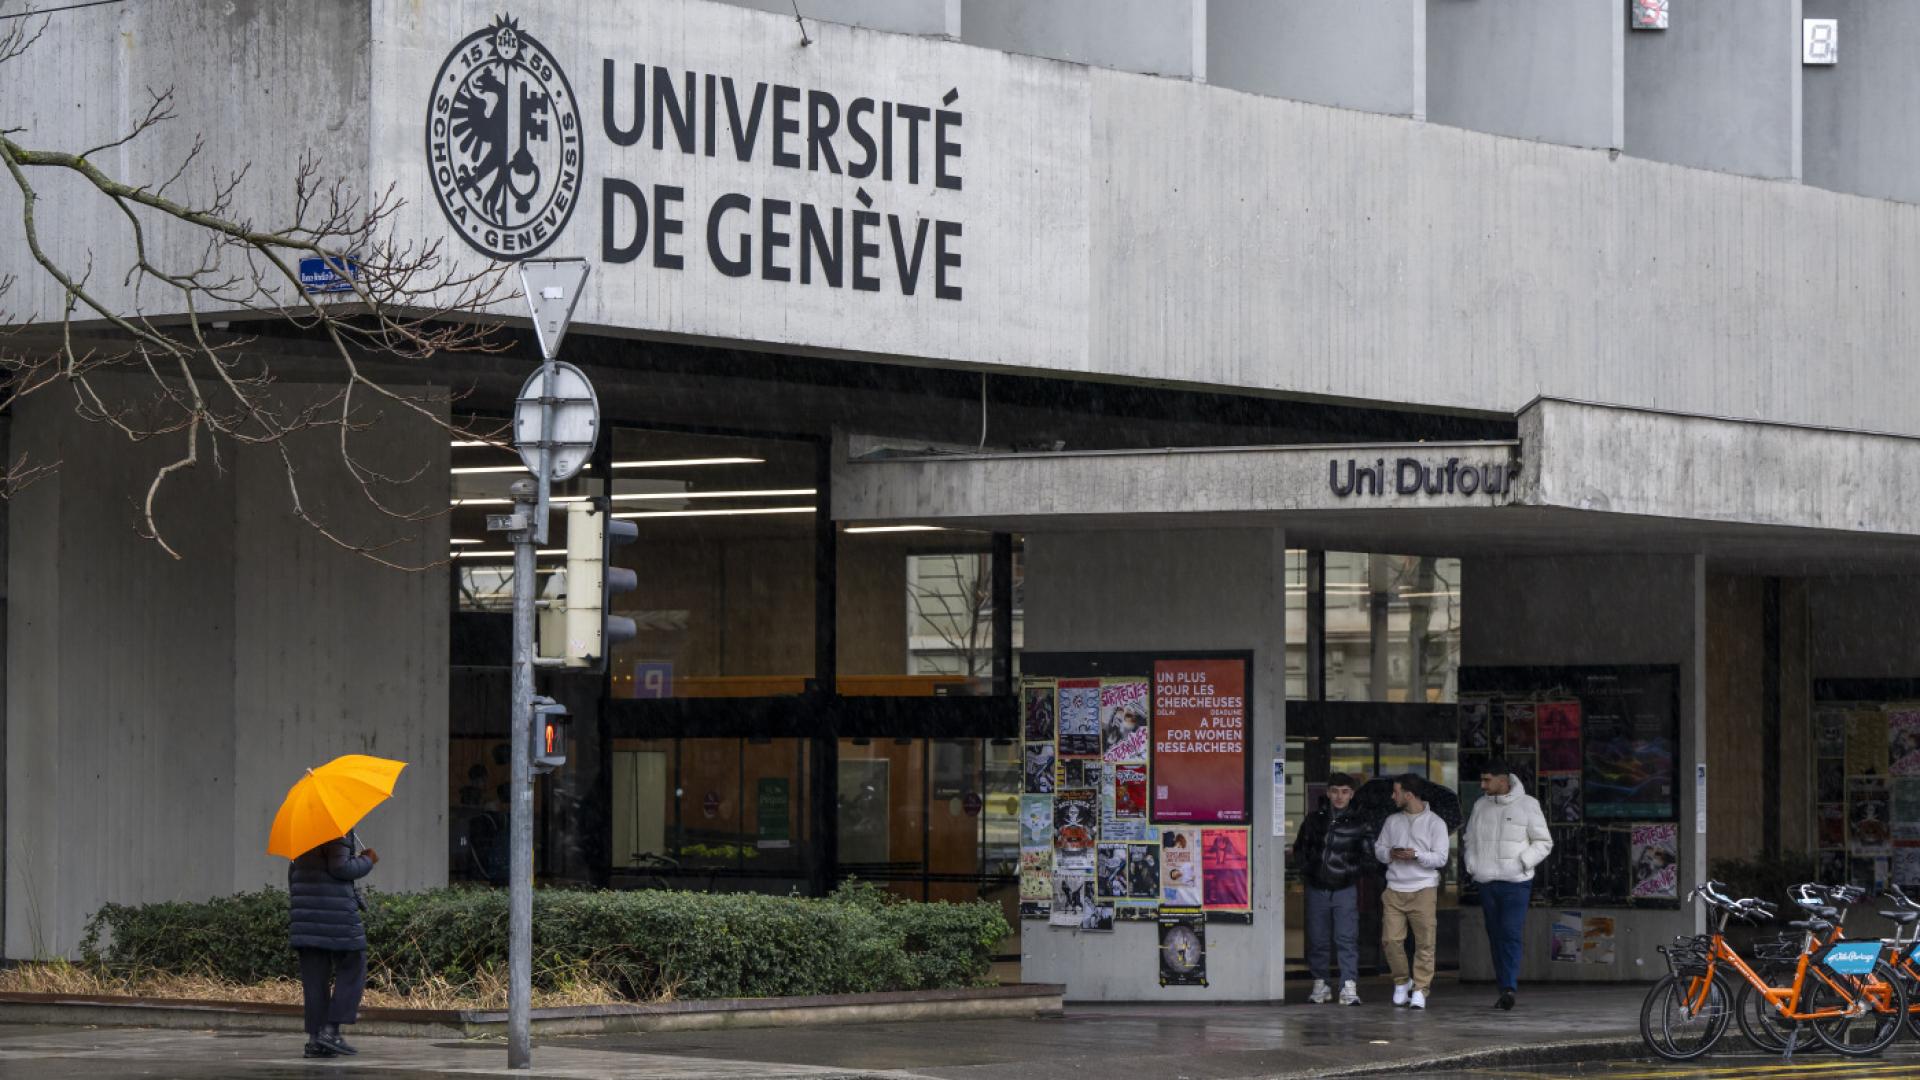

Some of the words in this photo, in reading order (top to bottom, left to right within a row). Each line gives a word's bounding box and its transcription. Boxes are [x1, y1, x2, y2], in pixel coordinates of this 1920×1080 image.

[461, 44, 483, 68] 15
[529, 54, 553, 82] 59
[602, 58, 963, 191] UNIVERSITÉ
[434, 94, 468, 226] SCHOLA
[484, 112, 577, 251] GENEVENSIS
[601, 177, 684, 271] DE
[706, 186, 963, 301] GENÈVE
[1330, 458, 1384, 497] Uni
[1396, 457, 1521, 496] Dufour
[1156, 671, 1174, 683] UN
[1176, 671, 1206, 683] PLUS
[1156, 684, 1190, 696] POUR
[1193, 684, 1215, 696] LES
[1156, 696, 1243, 708] CHERCHEUSES
[1200, 717, 1209, 728] A
[1212, 717, 1243, 728] PLUS
[1167, 729, 1191, 741] FOR
[1194, 729, 1243, 741] WOMEN
[1156, 741, 1243, 753] RESEARCHERS
